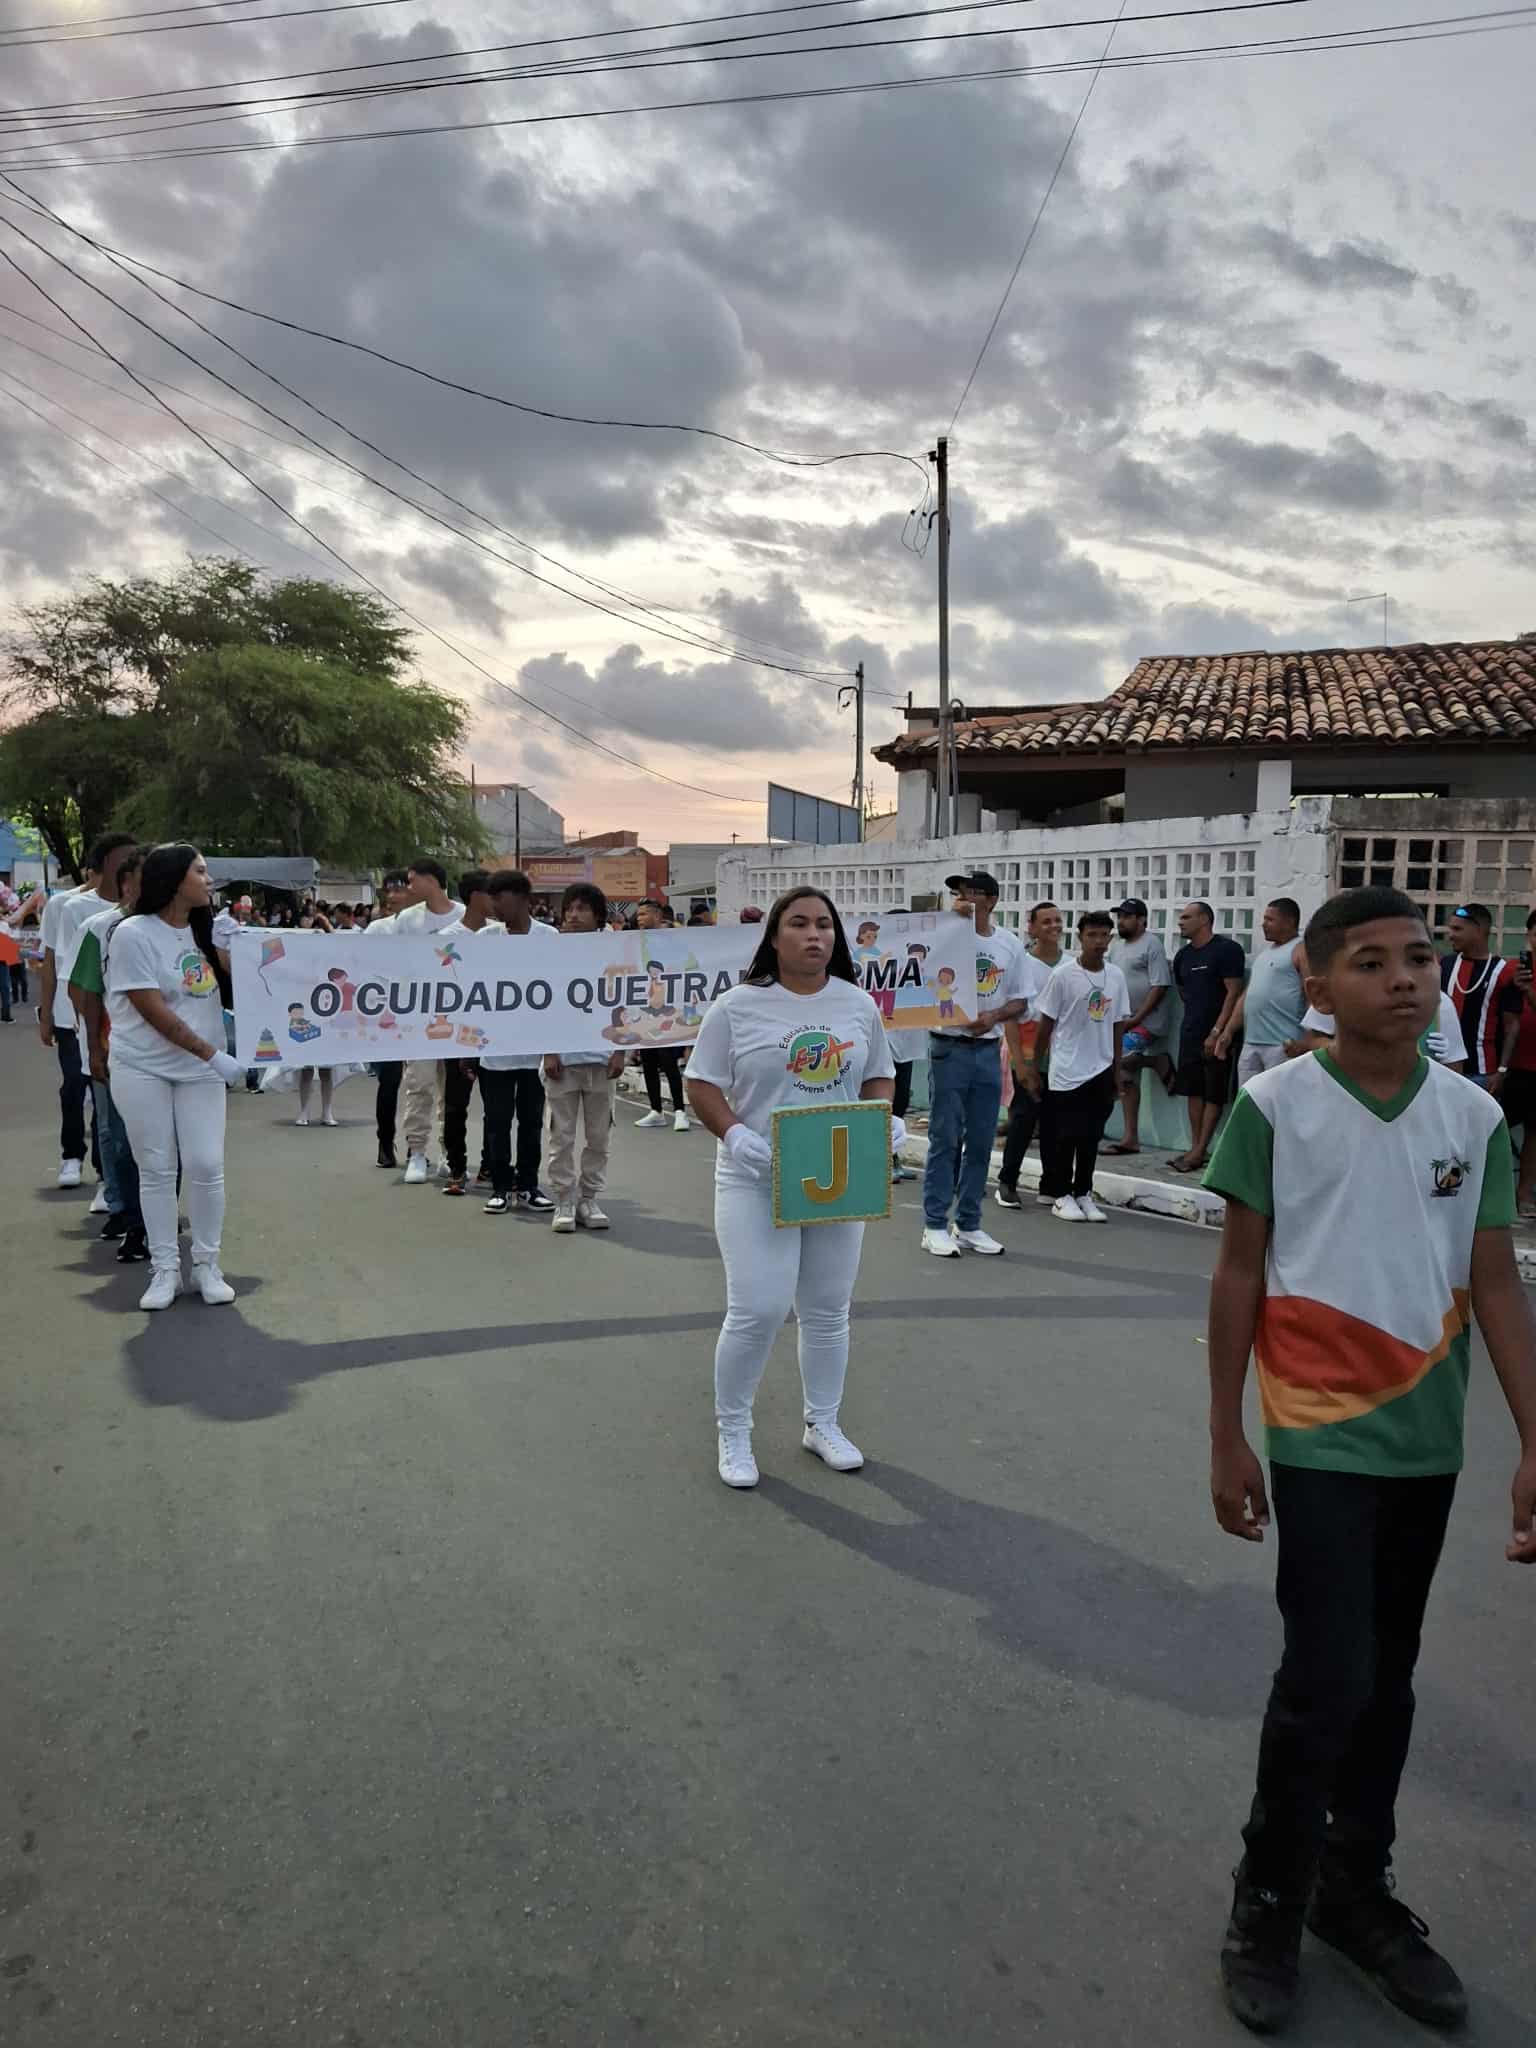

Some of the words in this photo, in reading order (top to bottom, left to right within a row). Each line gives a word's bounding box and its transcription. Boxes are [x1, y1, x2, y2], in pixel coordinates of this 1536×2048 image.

[310, 982, 340, 1017] O
[356, 979, 553, 1016] CUIDADO
[567, 975, 649, 1014] QUE
[786, 1034, 854, 1074] EJA
[793, 1080, 825, 1094] Jovens
[800, 1125, 849, 1204] J
